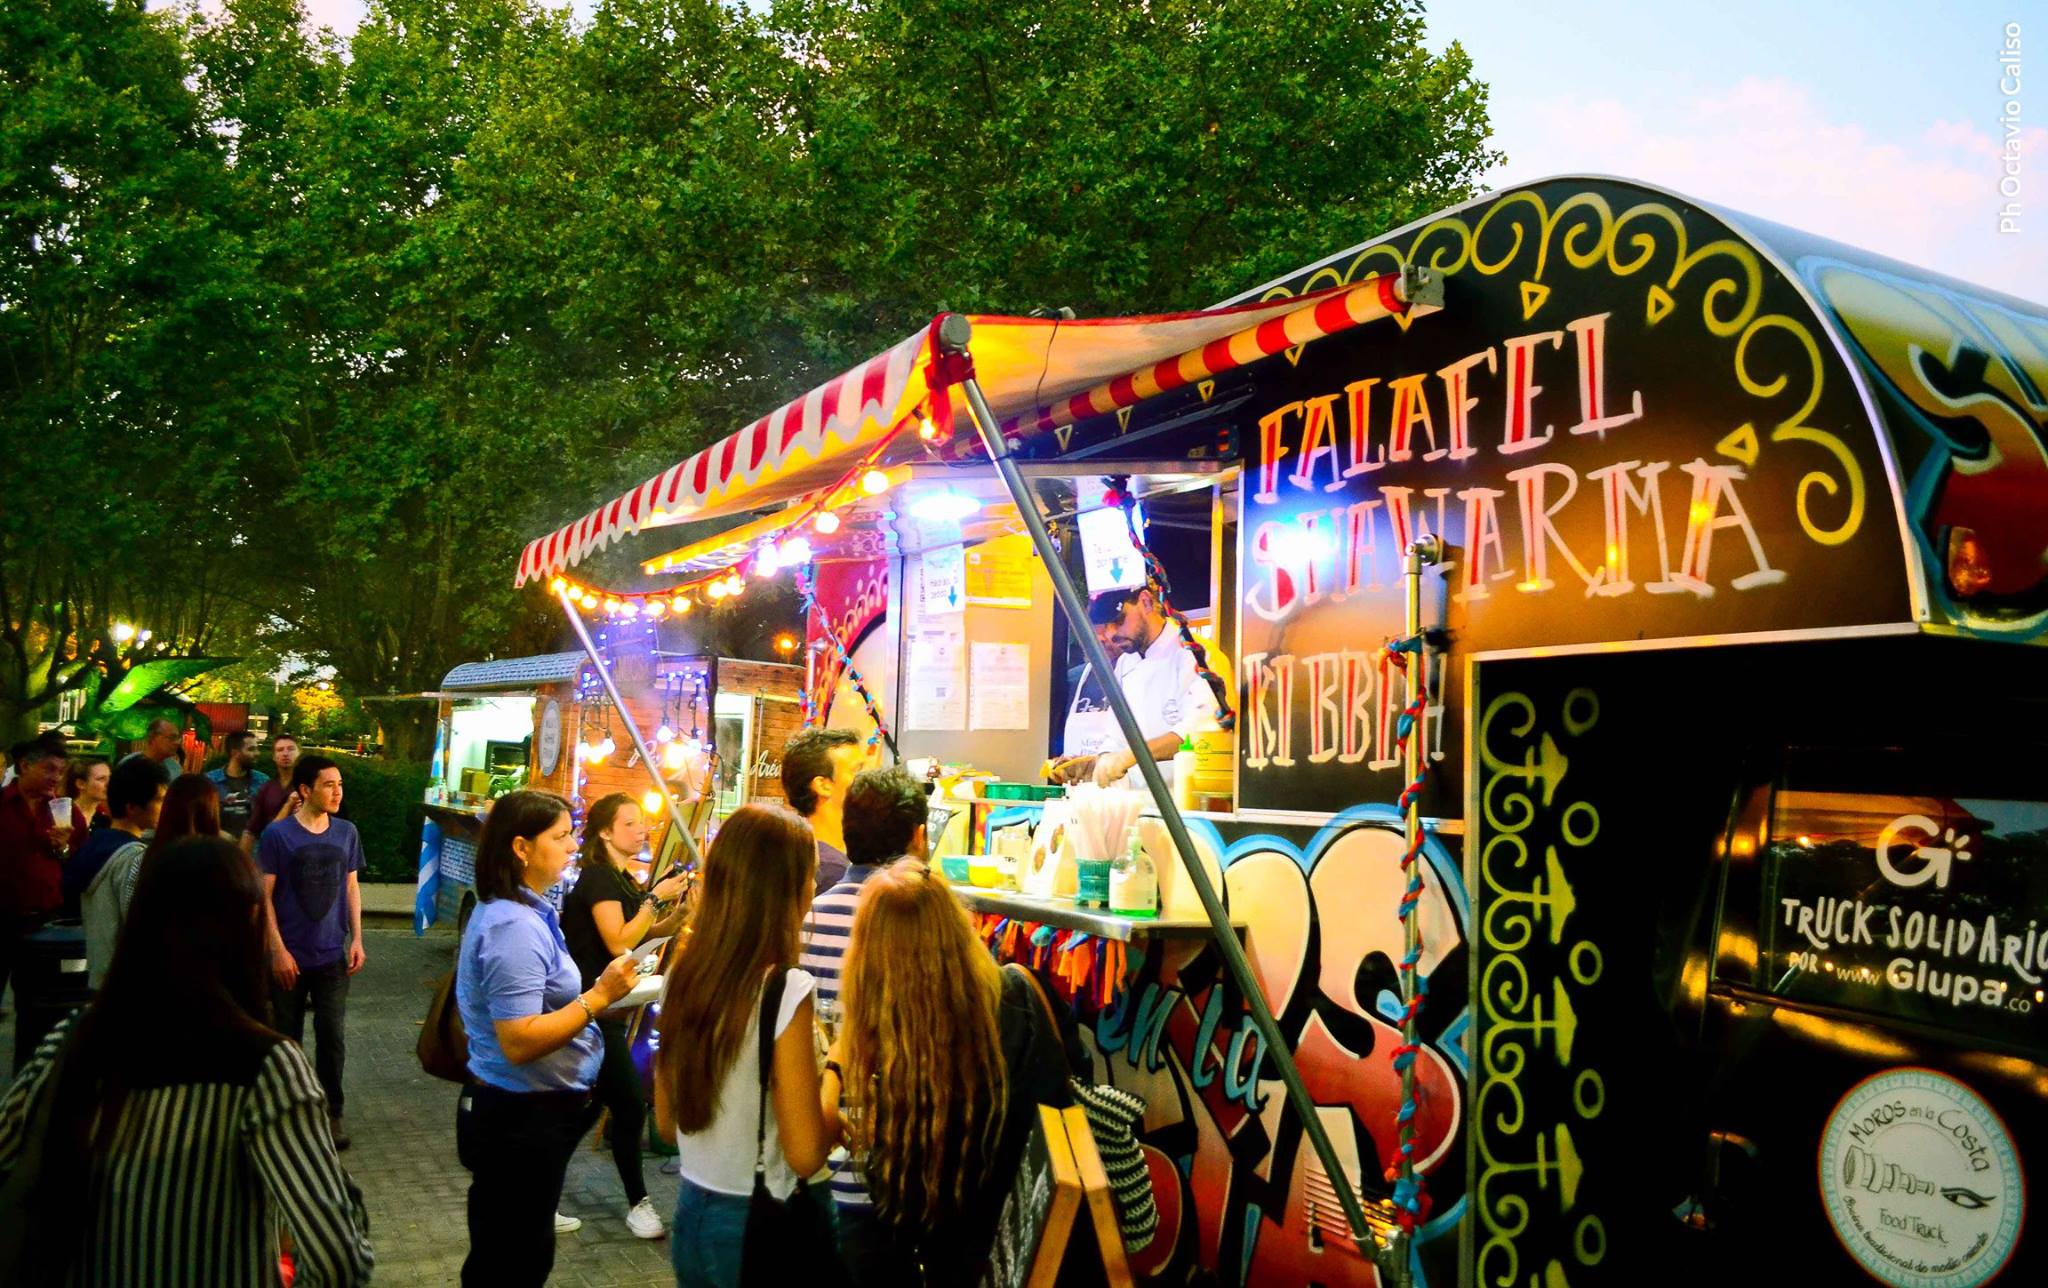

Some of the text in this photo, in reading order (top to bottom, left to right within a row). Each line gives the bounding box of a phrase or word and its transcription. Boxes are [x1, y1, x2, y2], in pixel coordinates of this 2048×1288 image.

[1254, 312, 1642, 503] FALAFEL
[1246, 458, 1787, 621] SHAWARMA
[1781, 896, 1877, 950] TRUCK
[1788, 951, 1818, 974] POR
[1193, 983, 1269, 1111] la
[1849, 1100, 1990, 1173] MOROS en la Costa
[1878, 1207, 1908, 1230] Food
